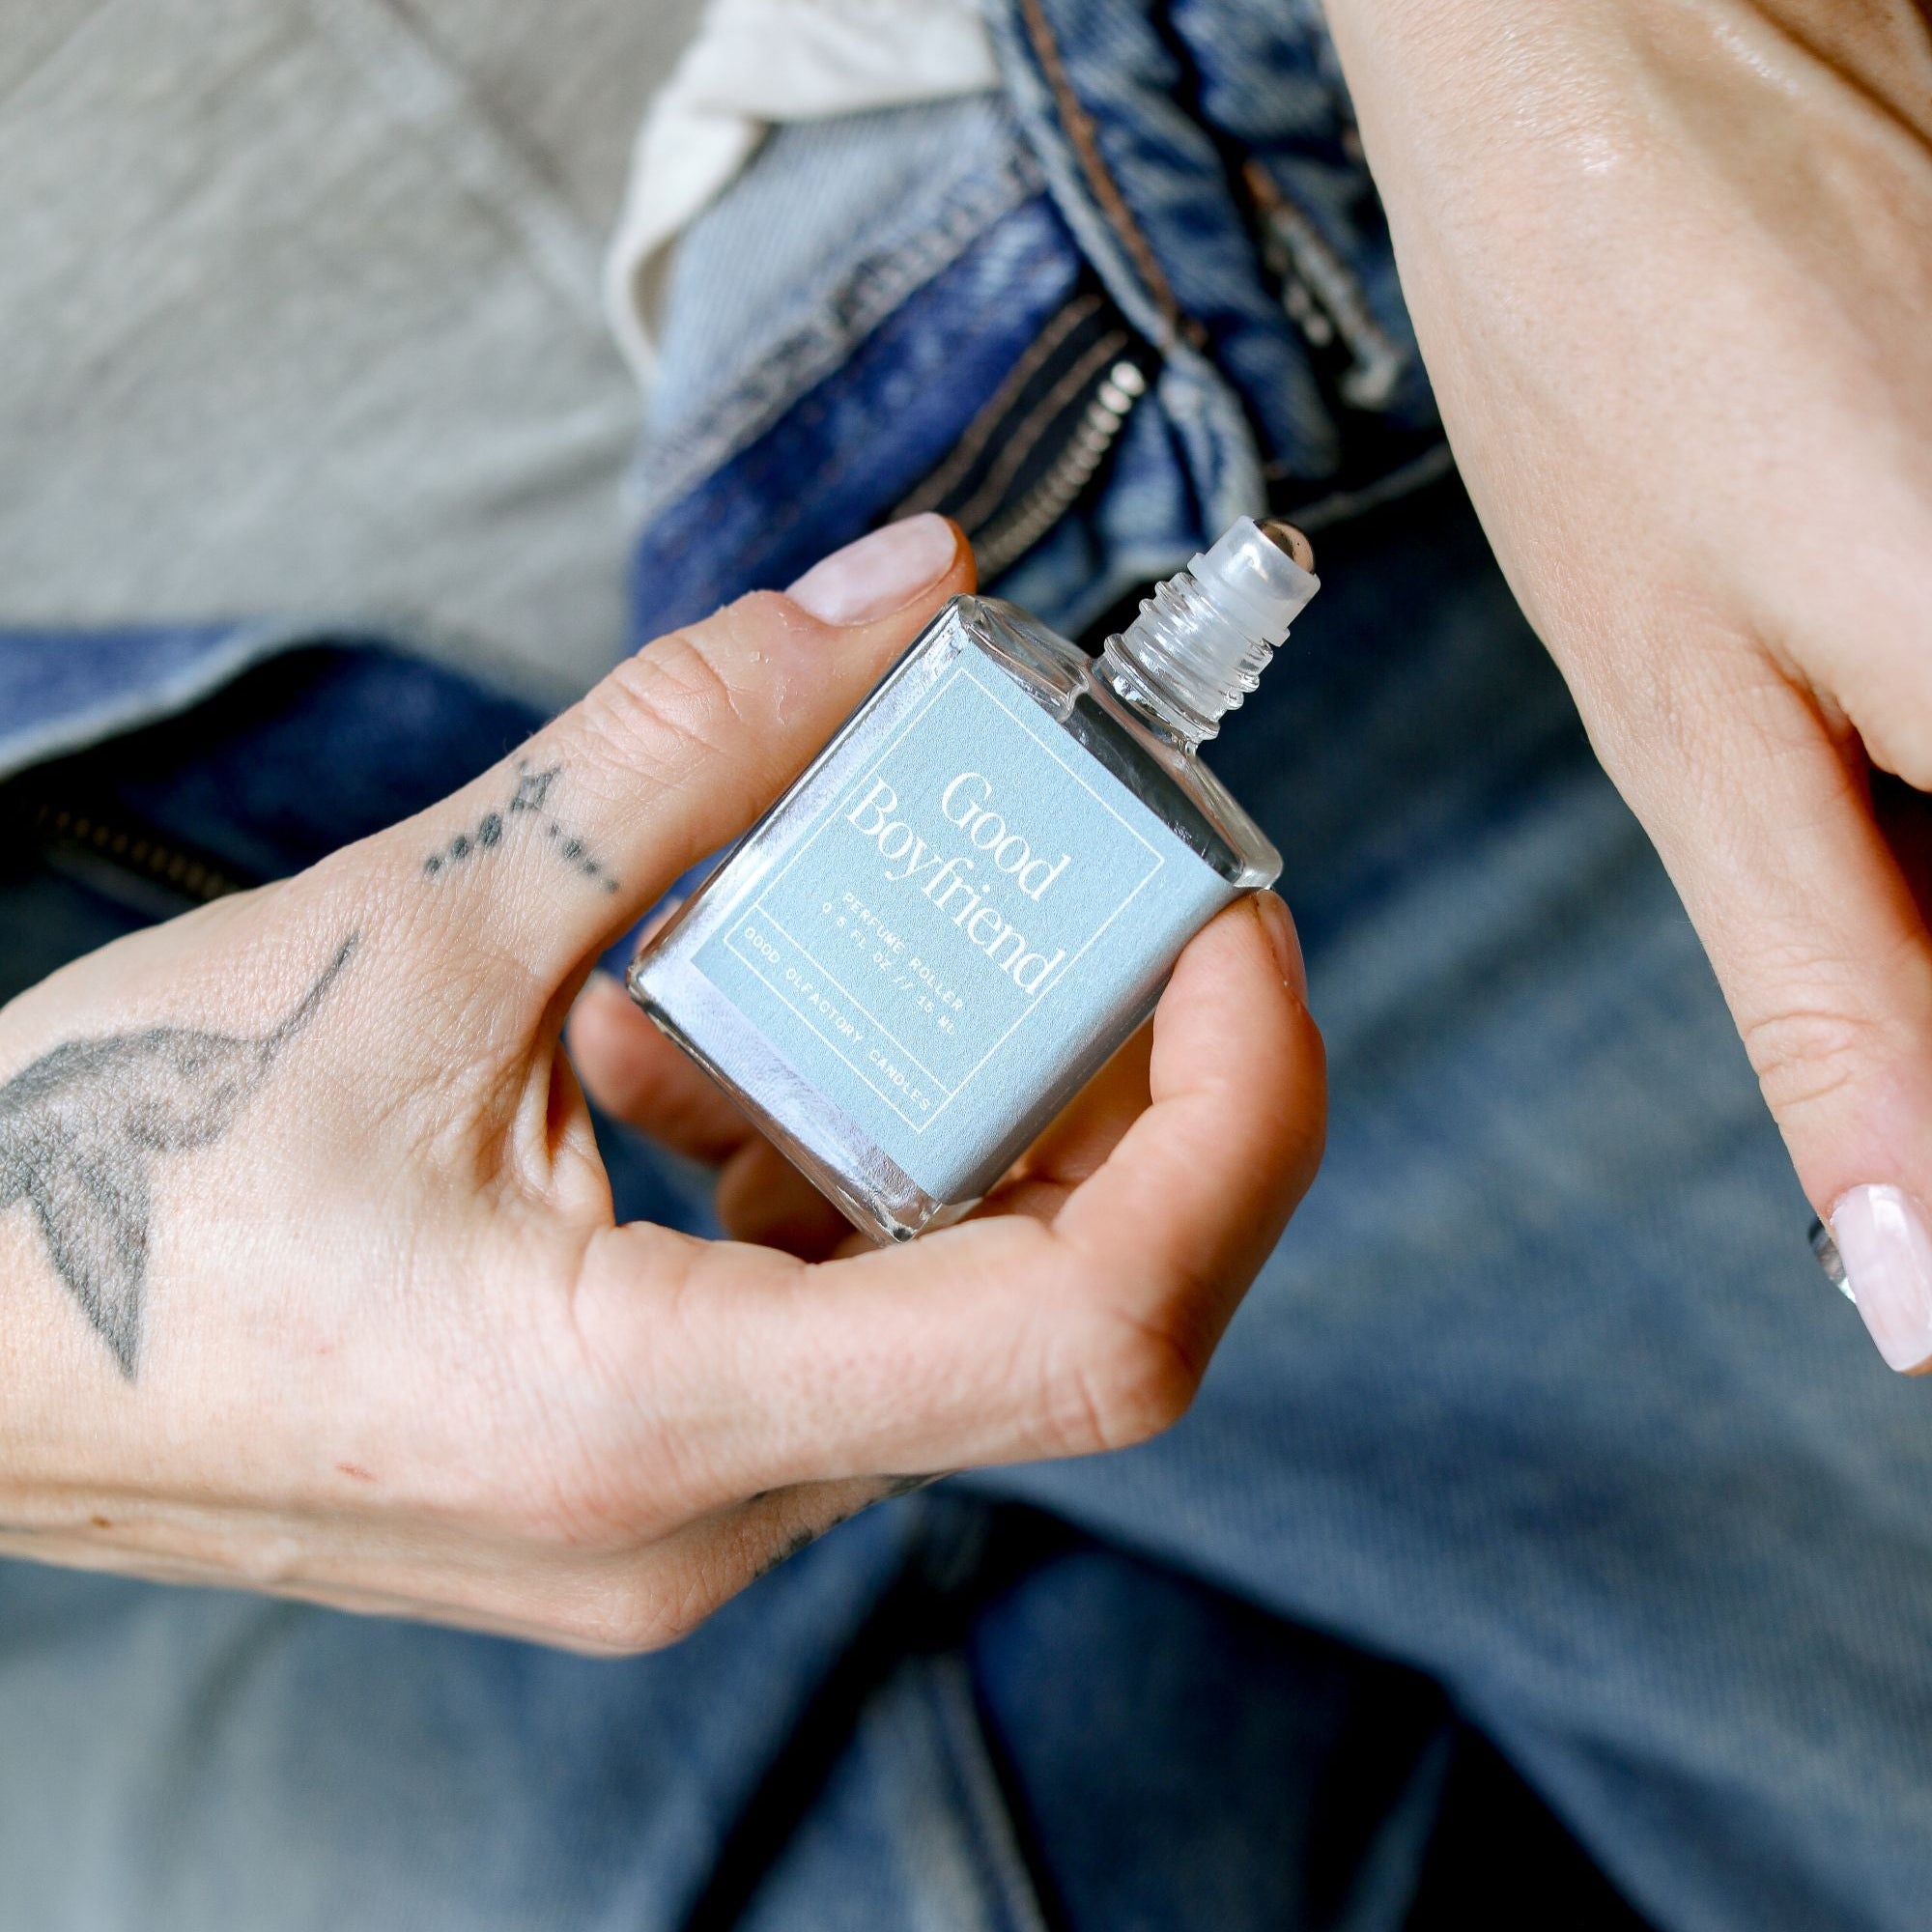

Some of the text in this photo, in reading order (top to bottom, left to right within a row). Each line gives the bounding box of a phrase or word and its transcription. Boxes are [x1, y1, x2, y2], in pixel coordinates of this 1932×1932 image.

[844, 777, 1066, 995] Boyfriend
[941, 772, 1071, 903] Good
[842, 892, 963, 1010] PERFUME ROLLER
[850, 929, 867, 950] FL
[872, 952, 892, 972] OZ
[916, 995, 935, 1014] 15
[937, 1014, 956, 1036] ML
[745, 926, 930, 1111] GOOD OLFACTORY CANDLES
